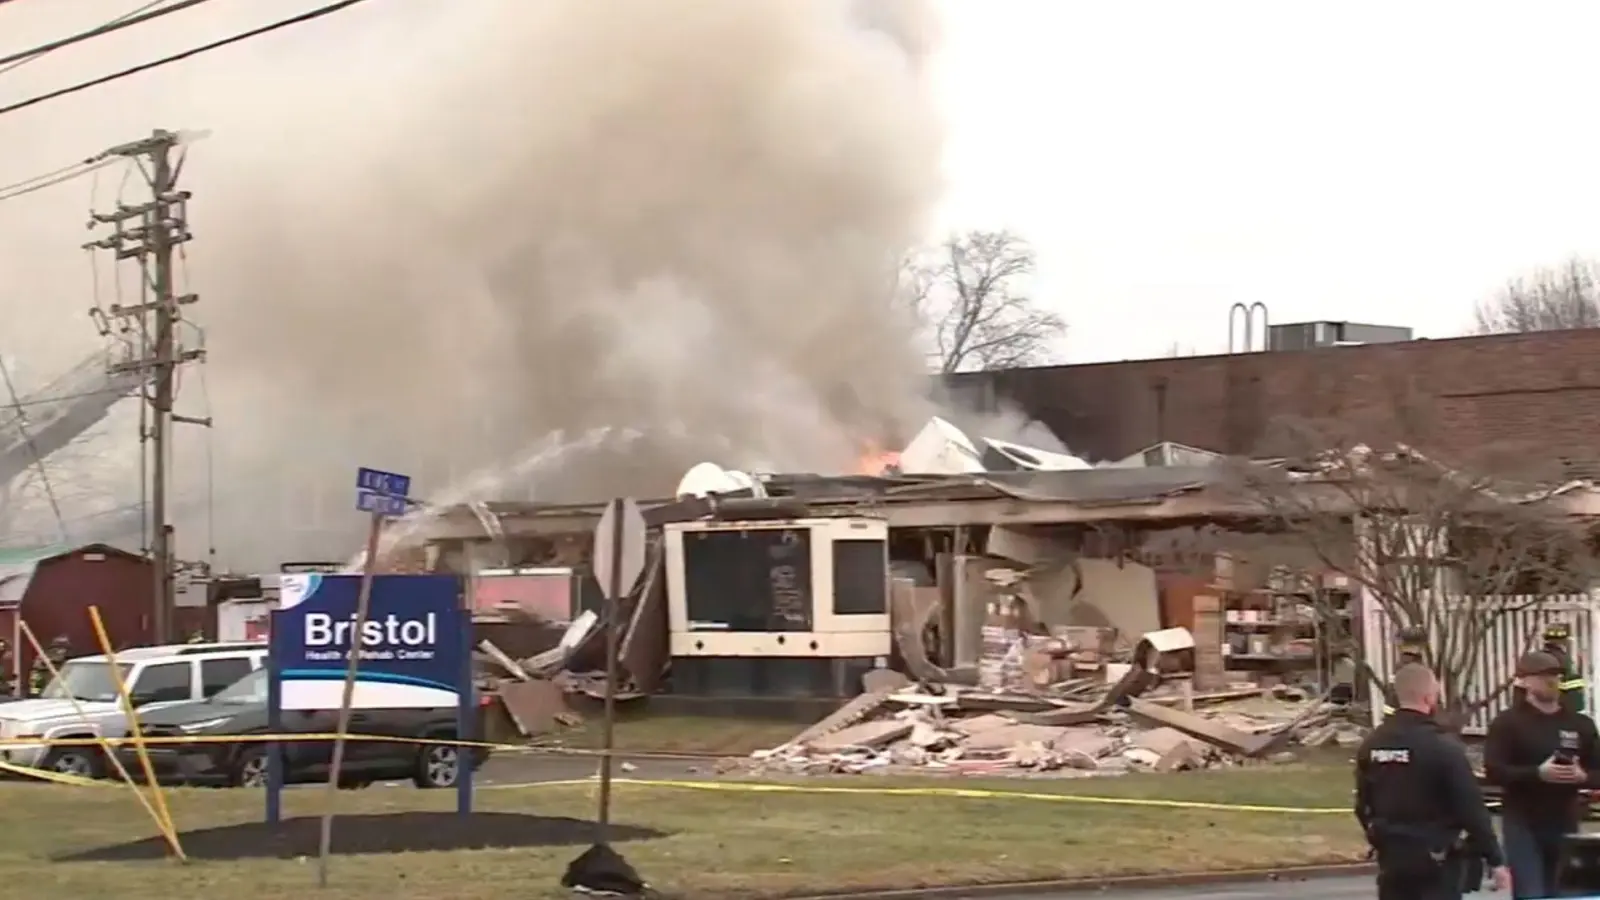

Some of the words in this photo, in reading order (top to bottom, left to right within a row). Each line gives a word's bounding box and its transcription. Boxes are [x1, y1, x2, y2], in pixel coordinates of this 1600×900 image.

[305, 612, 436, 645] Bristol
[305, 650, 342, 660] Health
[358, 650, 395, 660] Rehab
[397, 649, 435, 660] Center
